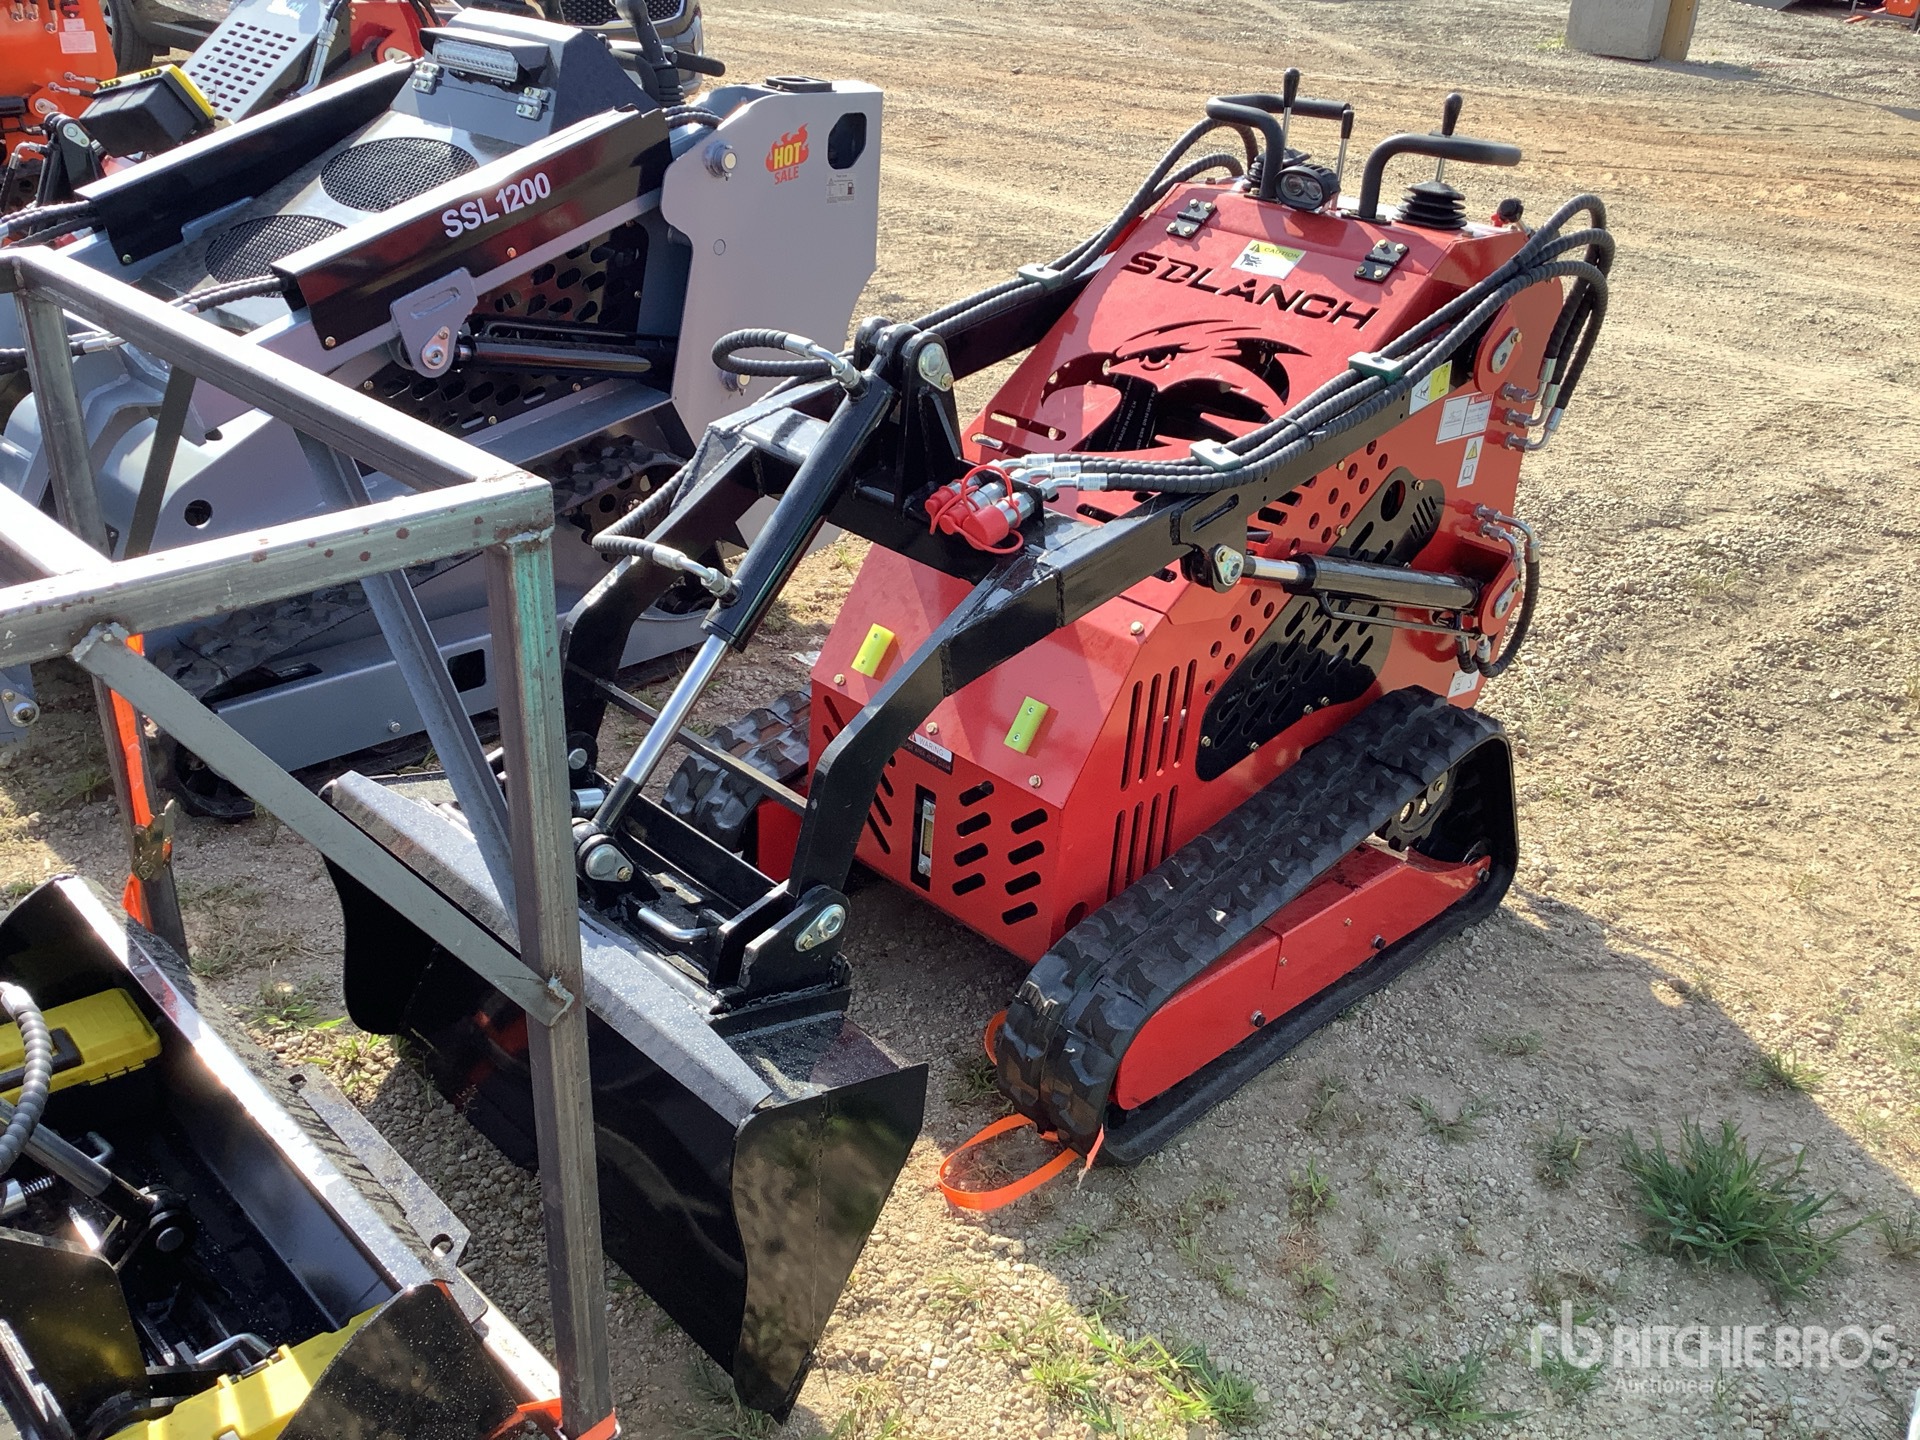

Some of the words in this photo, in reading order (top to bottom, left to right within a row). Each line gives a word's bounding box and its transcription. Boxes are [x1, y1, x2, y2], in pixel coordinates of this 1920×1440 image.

[773, 141, 801, 170] HOT
[774, 165, 800, 186] SALE
[442, 197, 499, 238] SSL
[496, 172, 551, 214] 1200
[1264, 247, 1300, 259] CAUTION
